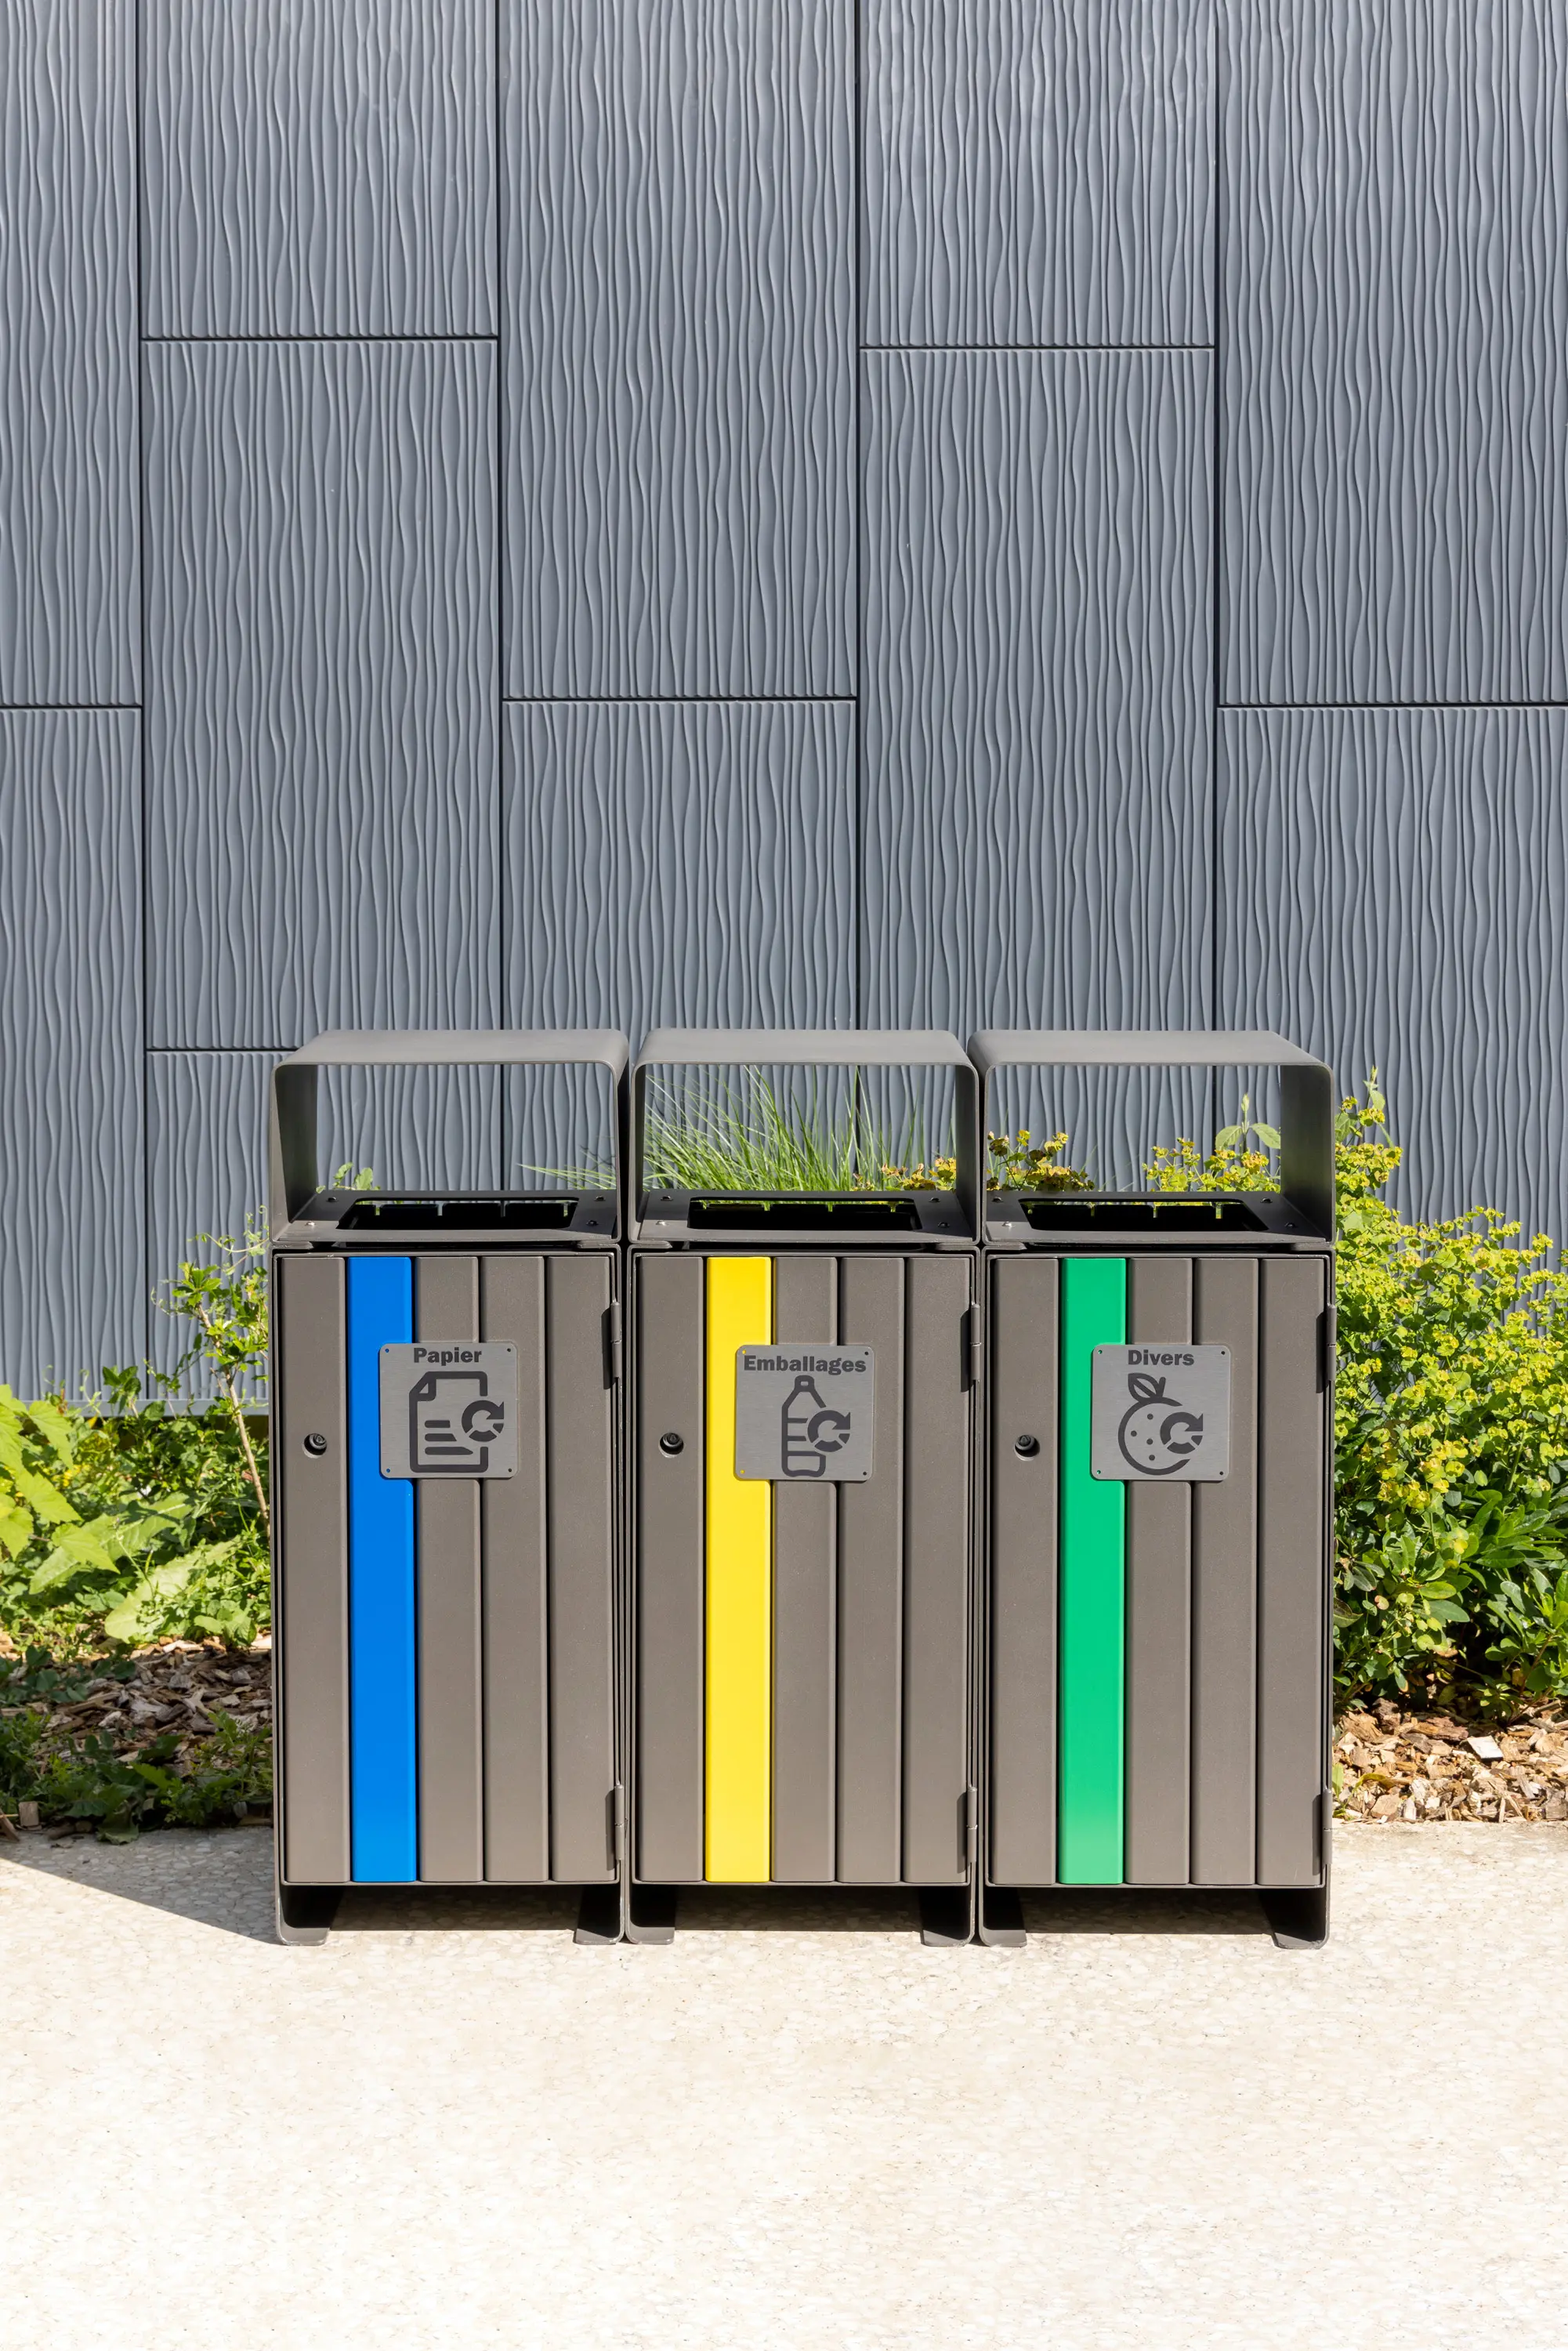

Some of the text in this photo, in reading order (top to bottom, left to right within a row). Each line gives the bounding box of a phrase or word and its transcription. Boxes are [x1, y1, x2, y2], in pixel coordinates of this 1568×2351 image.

[414, 1347, 482, 1366] Papier
[744, 1355, 867, 1375] Emballages
[1128, 1349, 1194, 1366] Divers
